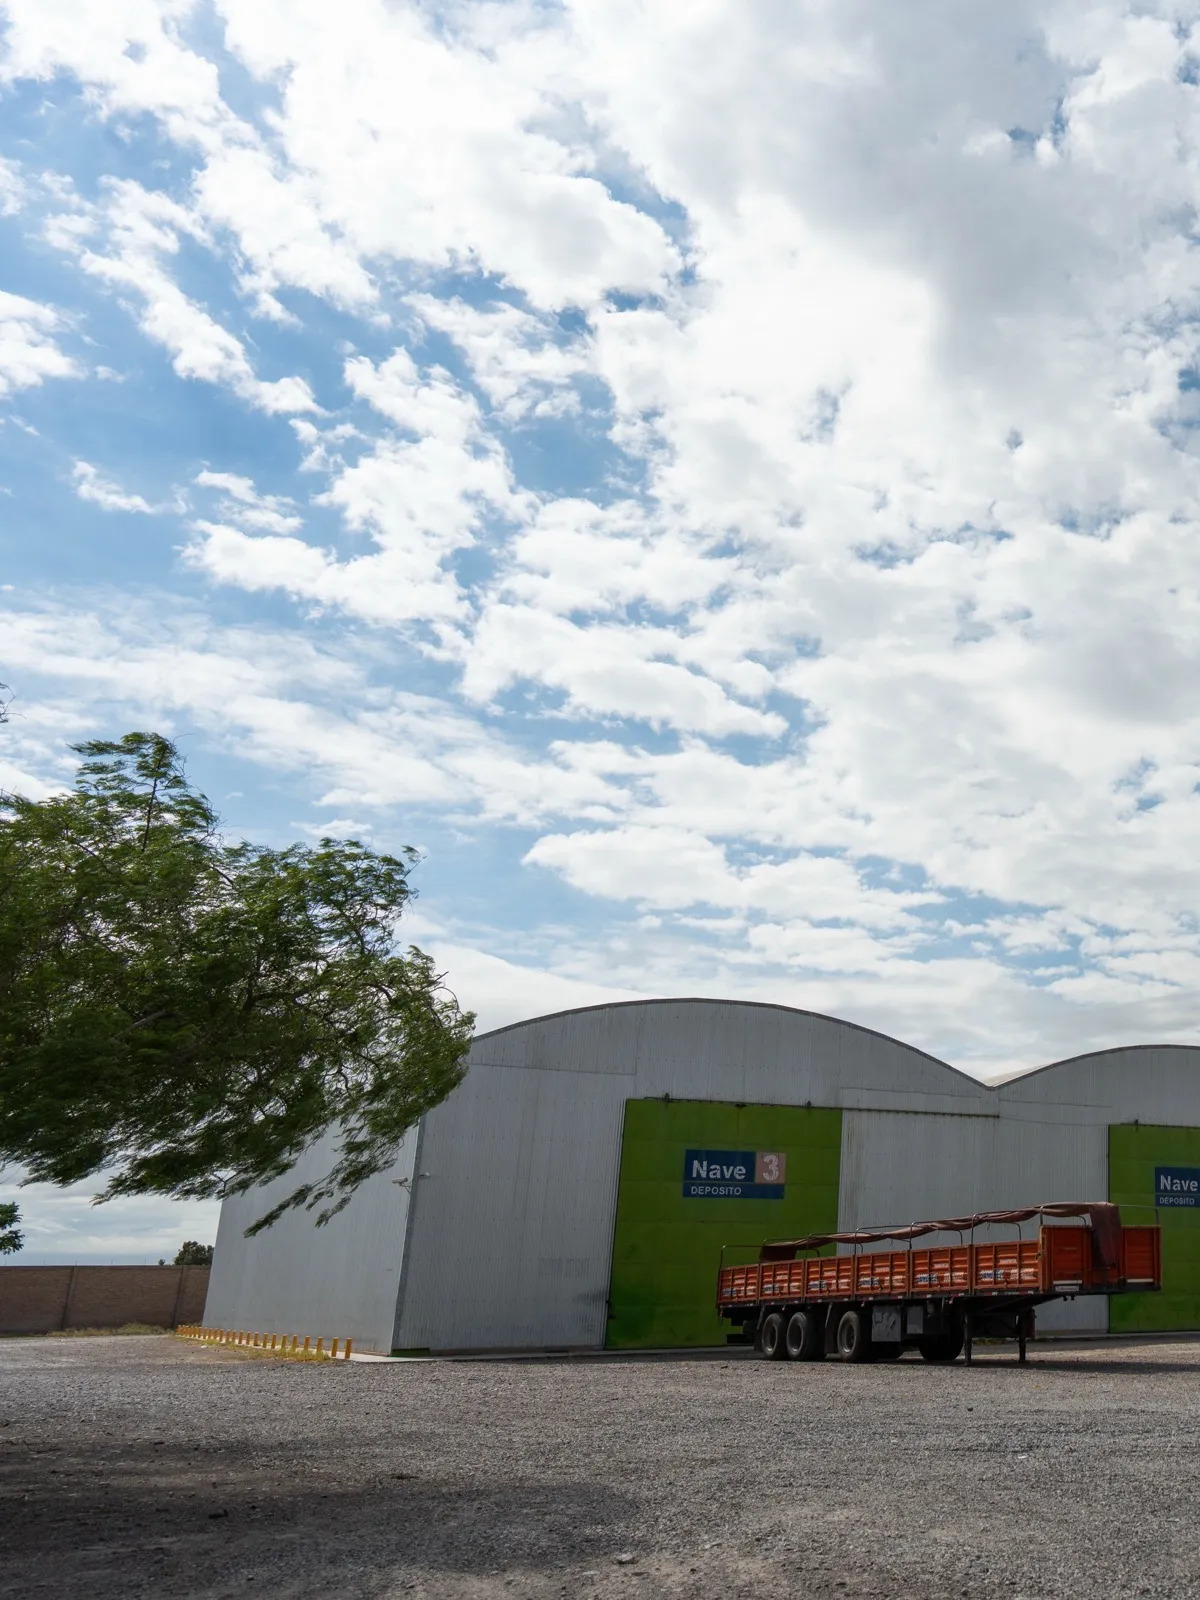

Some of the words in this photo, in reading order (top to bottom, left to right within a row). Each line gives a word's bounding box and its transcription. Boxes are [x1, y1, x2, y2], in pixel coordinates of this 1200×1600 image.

[692, 1160, 746, 1180] Nave
[763, 1154, 779, 1181] 3
[1160, 1174, 1198, 1192] Nave
[691, 1186, 741, 1195] DEPOSITO
[1160, 1197, 1195, 1205] DEPOSITO
